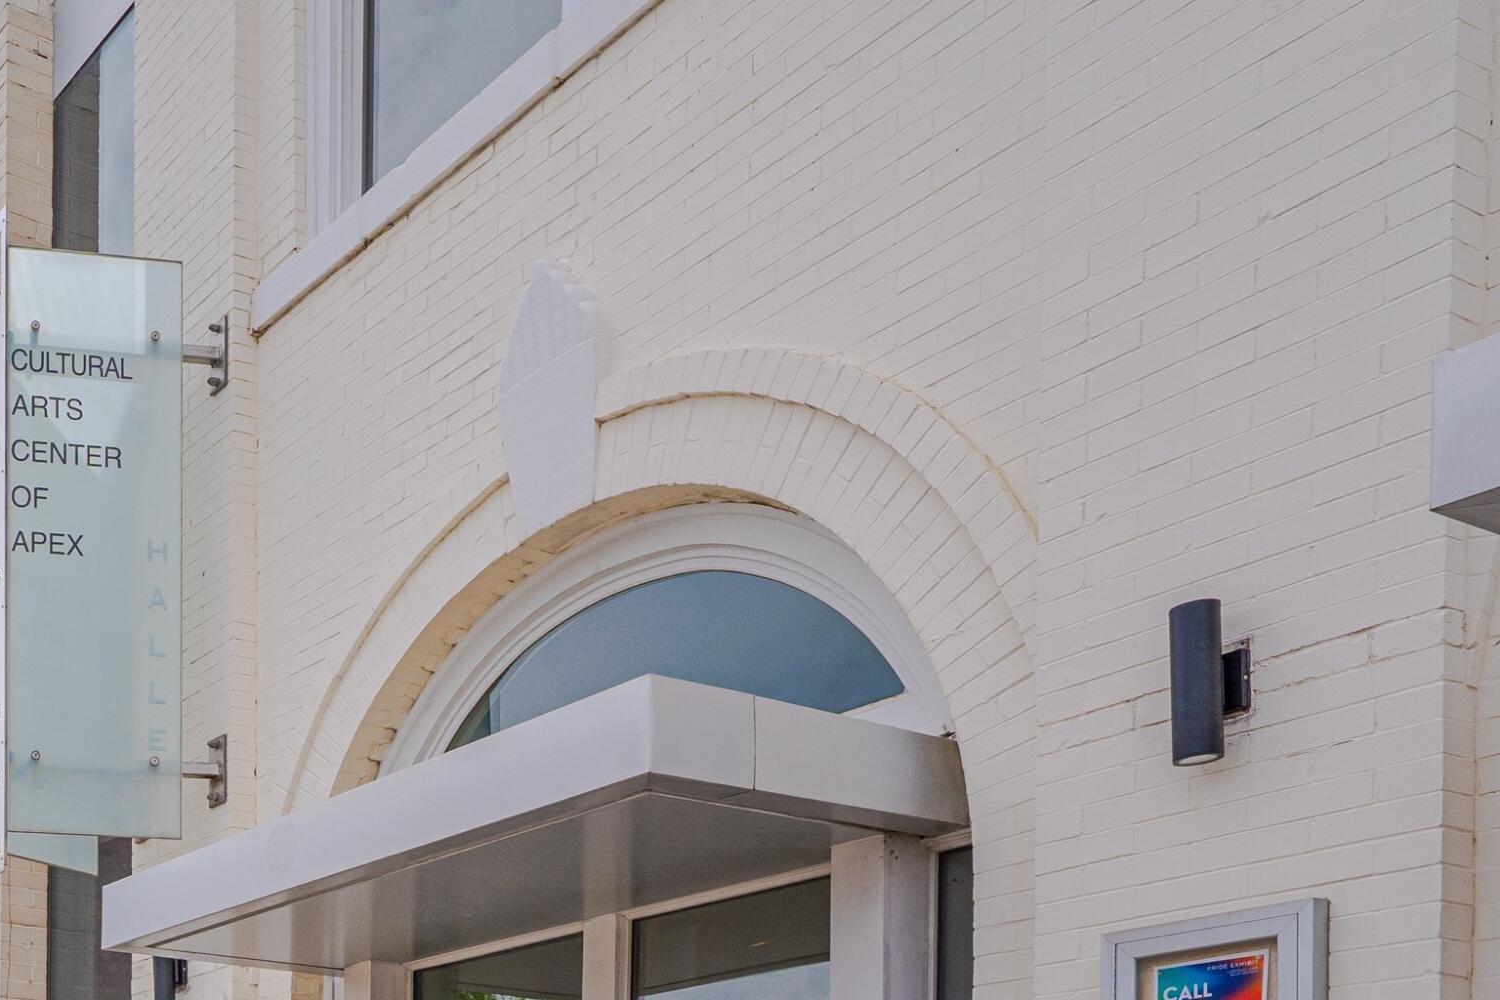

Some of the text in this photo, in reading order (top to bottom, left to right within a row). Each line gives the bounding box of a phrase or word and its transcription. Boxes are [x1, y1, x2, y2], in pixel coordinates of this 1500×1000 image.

[10, 348, 133, 380] CULTURAL
[10, 394, 84, 421] ARTS
[10, 438, 123, 469] CENTER
[10, 484, 49, 509] OF
[10, 530, 85, 557] APEX
[147, 539, 169, 752] HALLE
[1206, 964, 1228, 972] PRIDE
[1230, 959, 1259, 969] EXHIBIT
